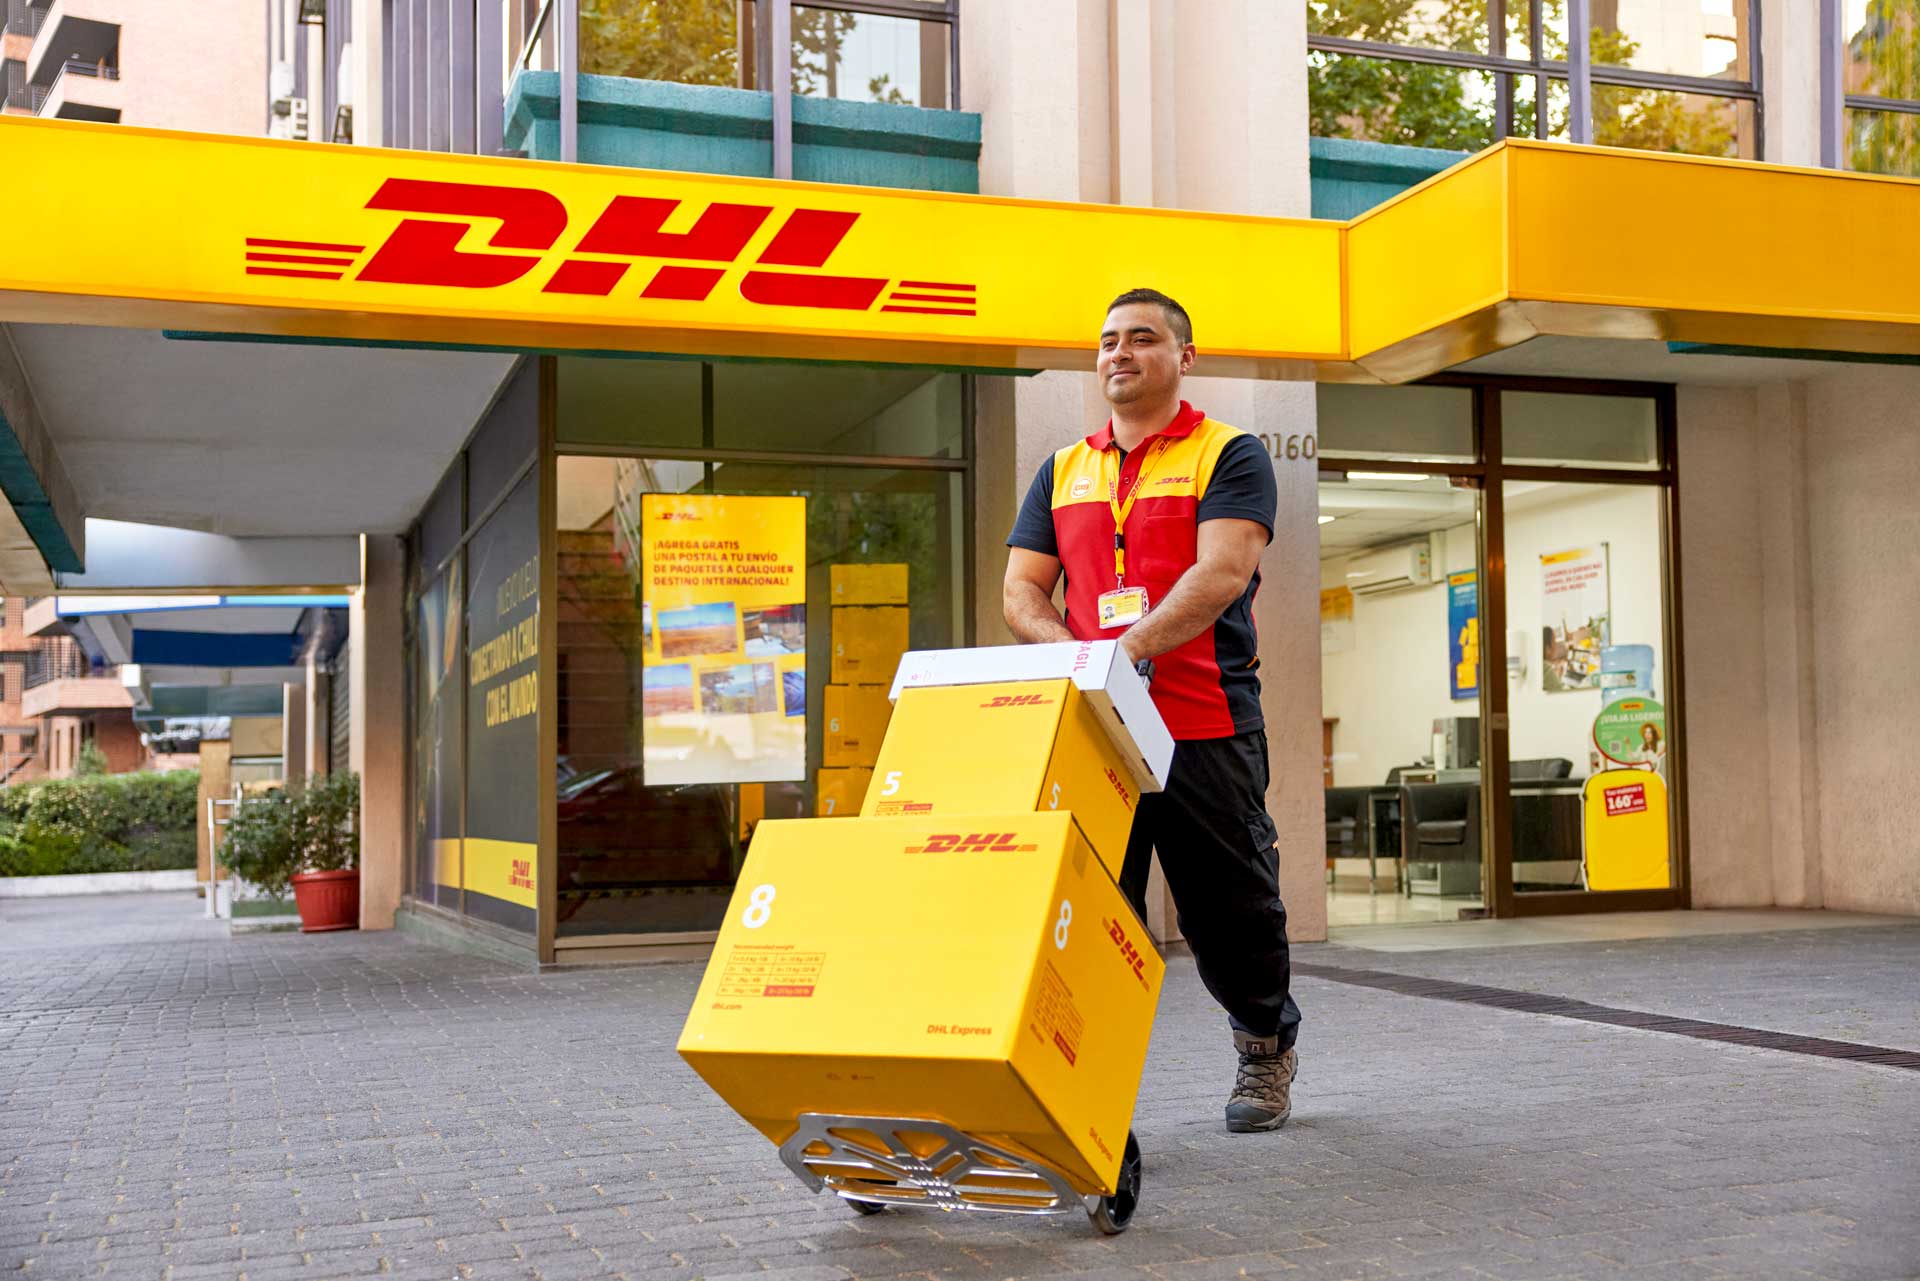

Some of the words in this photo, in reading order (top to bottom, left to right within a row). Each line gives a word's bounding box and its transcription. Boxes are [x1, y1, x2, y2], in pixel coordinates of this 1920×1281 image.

[355, 177, 889, 311] DHL
[703, 540, 740, 550] GRATIS
[654, 553, 675, 561] UNA
[679, 553, 718, 561] POSTAL
[721, 553, 728, 561] A
[731, 553, 744, 561] TU
[746, 550, 778, 561] ENVÍO
[654, 564, 666, 573] DE
[670, 565, 723, 574] PAQUETES
[727, 565, 733, 573] A
[736, 565, 793, 574] CUALQUIER
[654, 577, 699, 586] DESTINO
[702, 577, 789, 586] INTERNACIONAL!
[992, 694, 1043, 707] DHL
[830, 718, 840, 732] 6
[880, 771, 903, 796] 5
[1108, 768, 1130, 806] DHL
[1049, 782, 1061, 810] 5
[825, 799, 836, 815] 7
[921, 833, 1018, 853] DHL
[742, 884, 776, 928] 8
[1055, 899, 1072, 951] 8
[1108, 918, 1145, 982] DHL
[927, 1024, 948, 1034] DHL
[951, 1025, 992, 1036] Express
